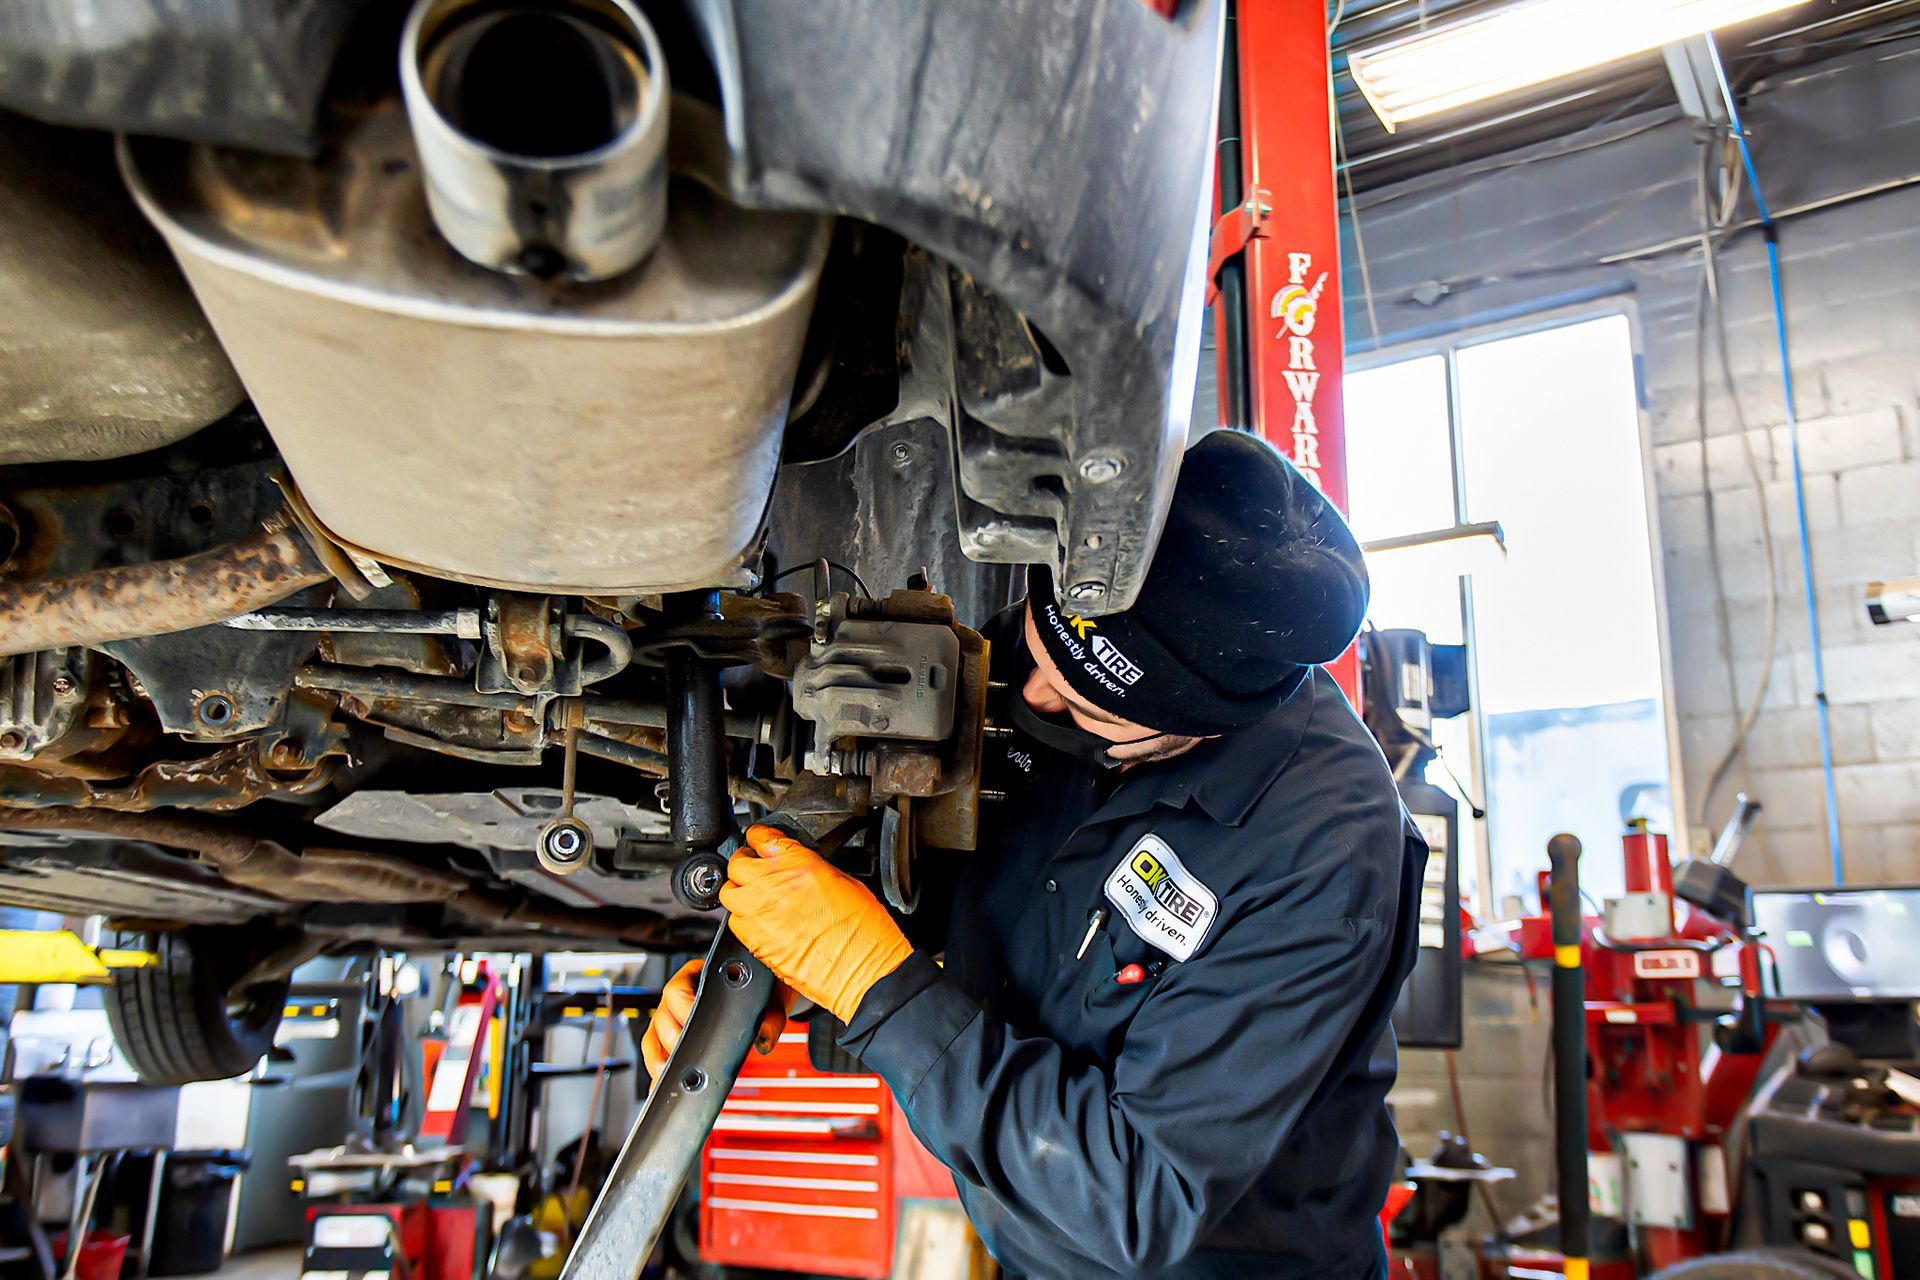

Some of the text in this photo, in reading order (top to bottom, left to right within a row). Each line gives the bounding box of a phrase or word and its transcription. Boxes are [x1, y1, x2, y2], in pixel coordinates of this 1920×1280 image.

[1044, 604, 1126, 698] Honestly driven.
[1067, 614, 1142, 684] K TIRE
[1116, 874, 1187, 946] Honesty driven.
[1131, 850, 1200, 924] OK TIRE
